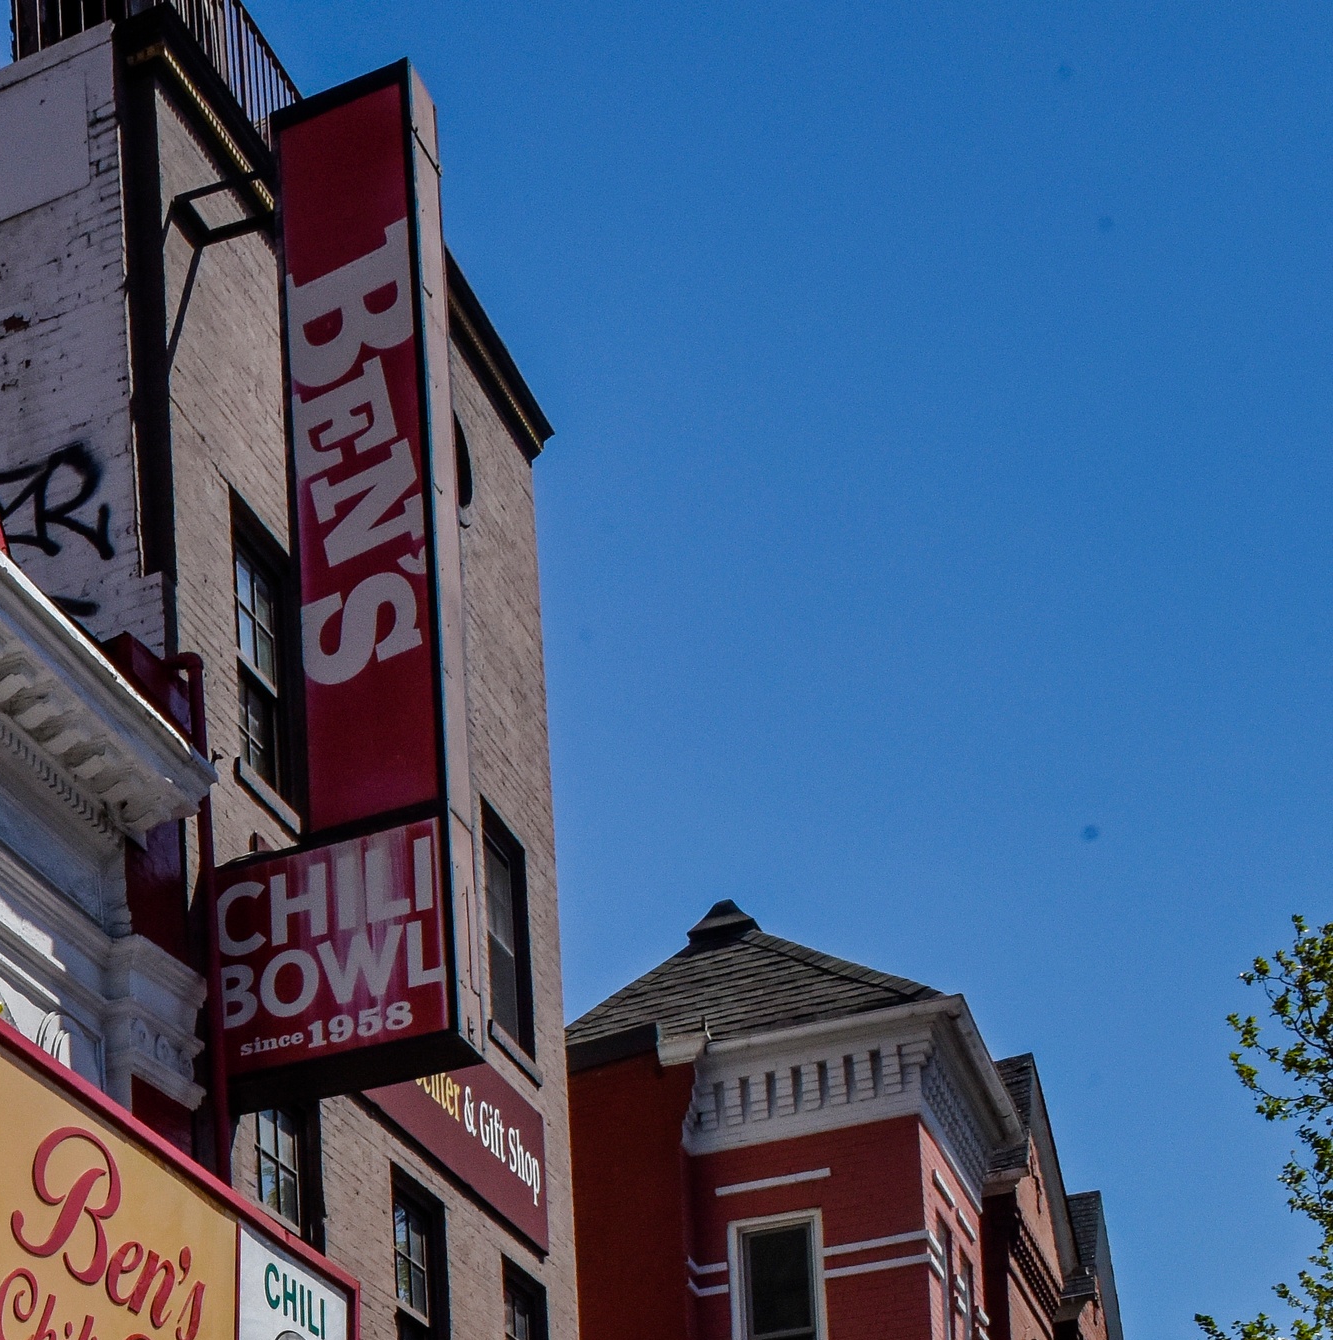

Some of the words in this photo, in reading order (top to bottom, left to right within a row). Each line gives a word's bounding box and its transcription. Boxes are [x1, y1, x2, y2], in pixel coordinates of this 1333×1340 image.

[286, 216, 427, 685] BEN'S
[216, 835, 432, 957] CHILI
[221, 920, 445, 1029] BOWL
[241, 1031, 303, 1057] since
[307, 1000, 413, 1050] 1958
[464, 1086, 477, 1137] &
[479, 1101, 506, 1163] Gift
[508, 1127, 541, 1206] Shop
[264, 1262, 327, 1340] CHILI
